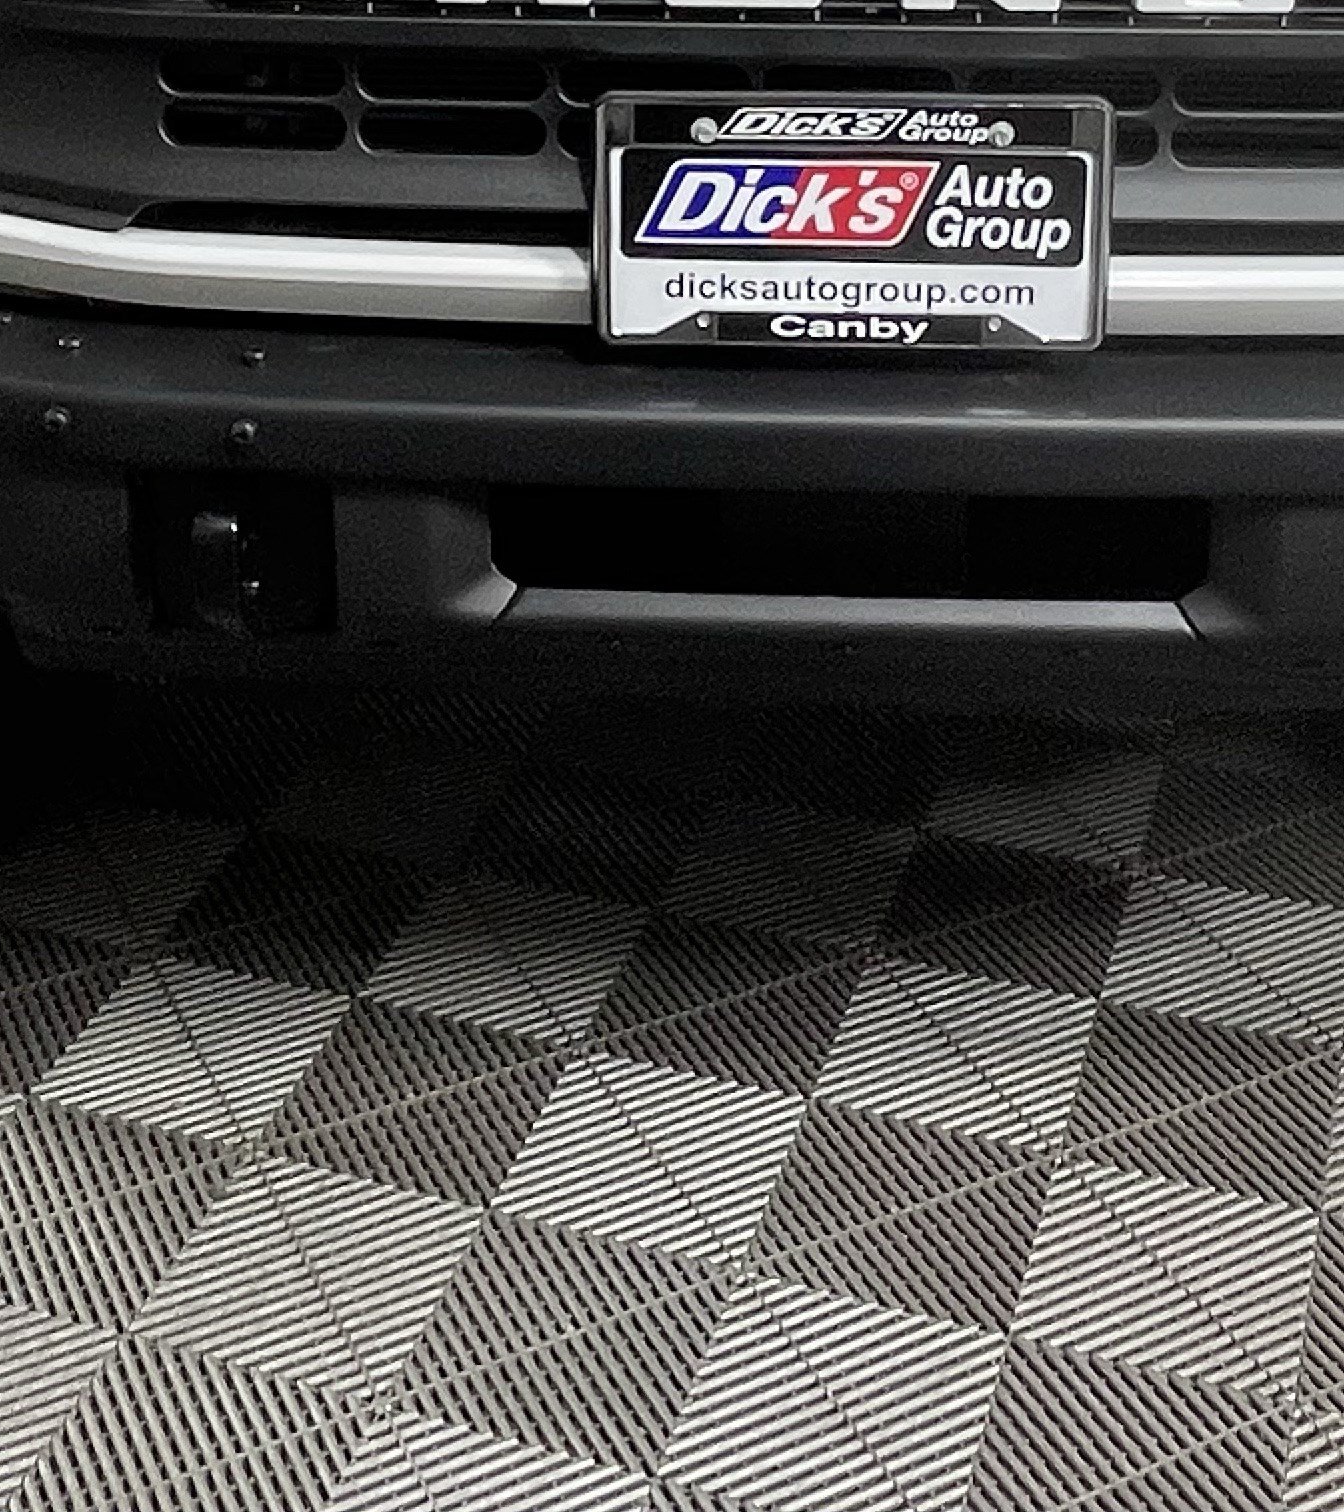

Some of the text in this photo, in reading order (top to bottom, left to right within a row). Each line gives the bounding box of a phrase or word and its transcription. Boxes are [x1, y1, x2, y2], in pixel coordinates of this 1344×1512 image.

[730, 110, 885, 136] Dick's
[910, 110, 979, 127] Auto
[899, 126, 989, 145] Group
[657, 170, 905, 234] Dick's
[935, 164, 1054, 209] Auto
[925, 207, 1072, 259] Group
[665, 273, 1035, 307] dicksautogroup.com
[770, 314, 929, 344] Canby
